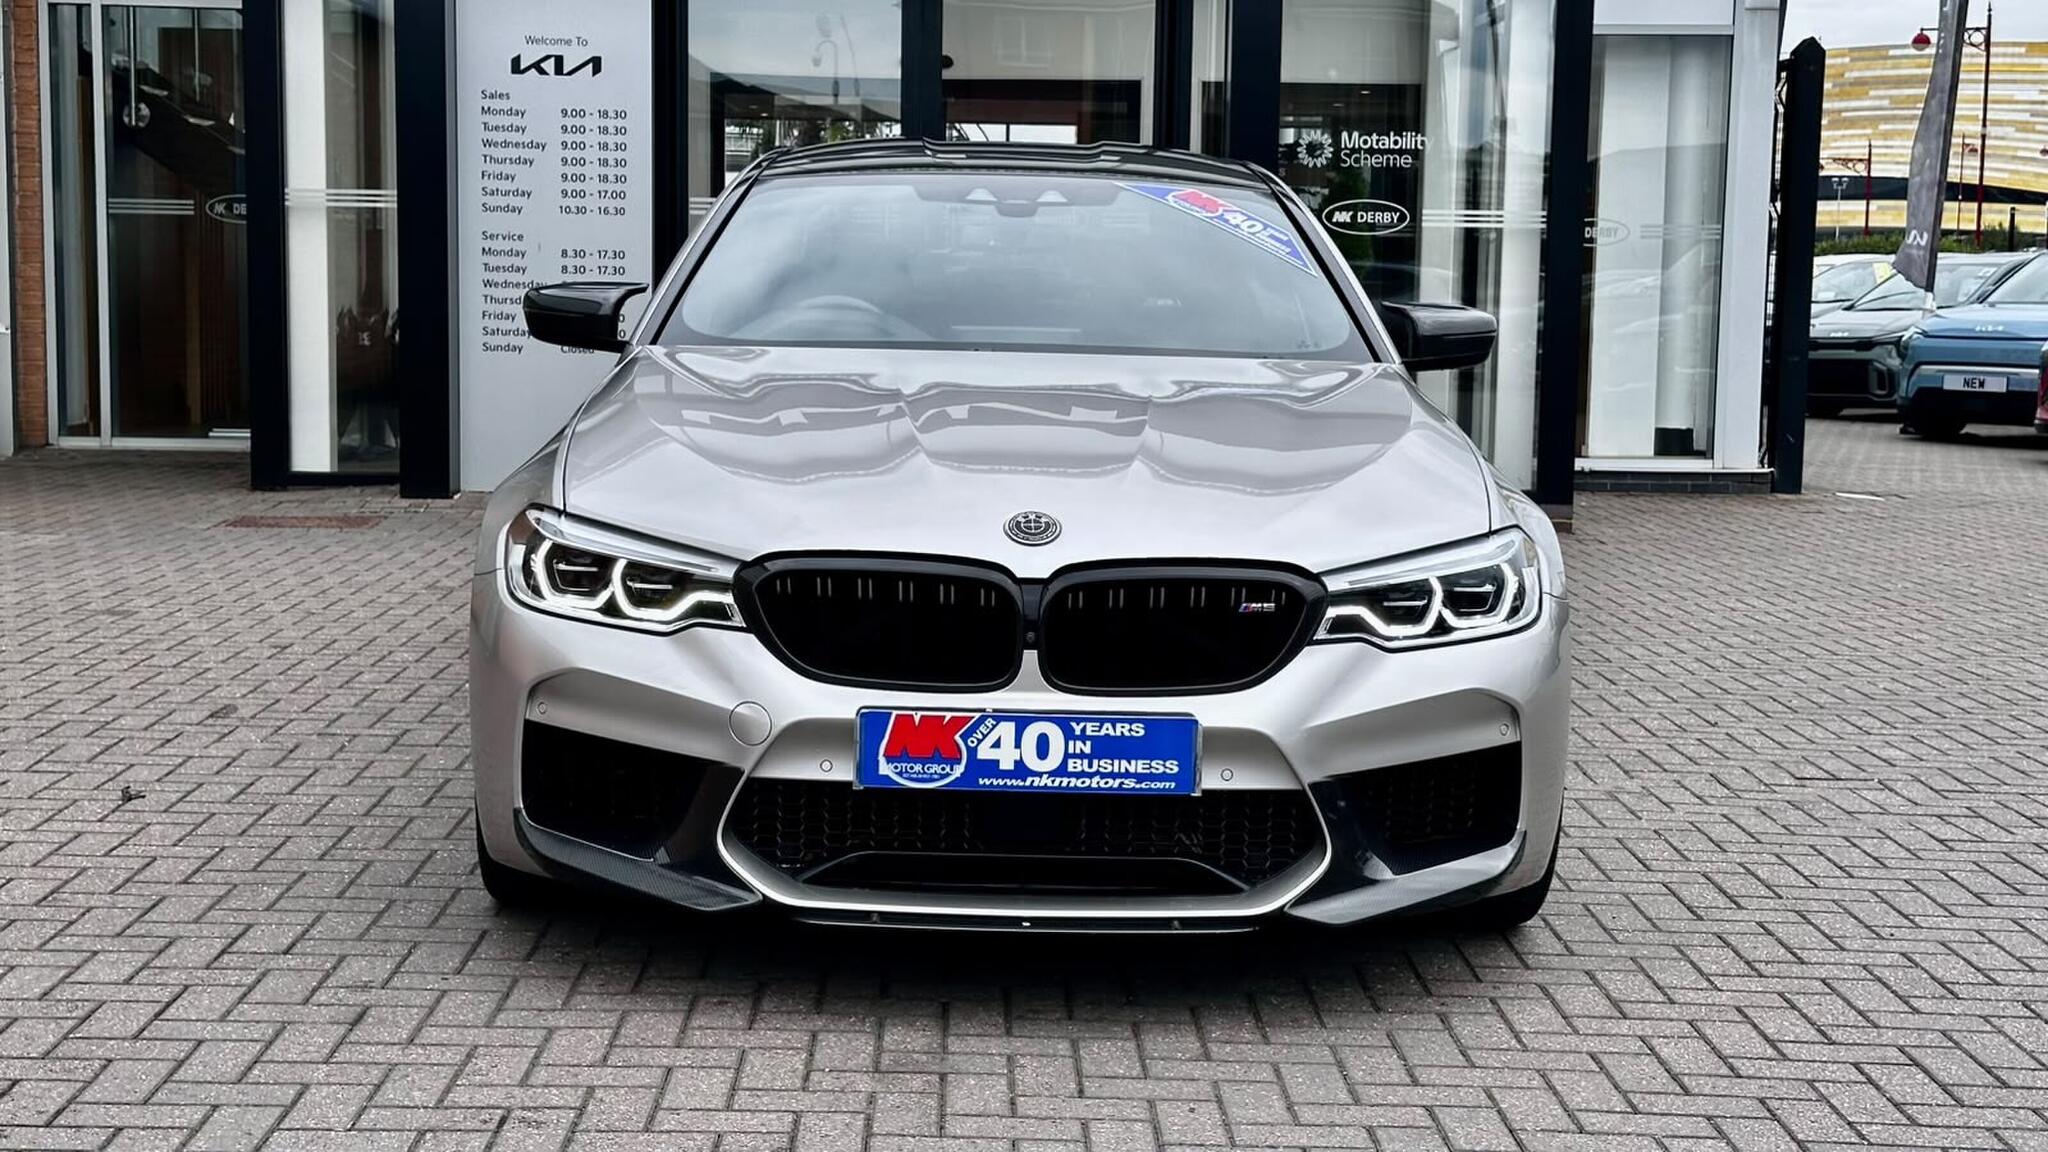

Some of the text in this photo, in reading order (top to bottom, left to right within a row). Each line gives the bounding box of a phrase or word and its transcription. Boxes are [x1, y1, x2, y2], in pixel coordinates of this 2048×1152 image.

[525, 36, 588, 47] Welcome To
[511, 54, 601, 77] KIA
[481, 90, 510, 100] Sales
[481, 106, 525, 118] Monday
[561, 109, 586, 118] 9.00
[598, 109, 627, 119] 18.30
[482, 122, 527, 135] Tuesday
[561, 125, 586, 134] 9.00
[598, 126, 626, 135] 18.30
[482, 138, 546, 152] Wednesday
[561, 141, 586, 150] 9.00
[598, 142, 626, 151] 18.30
[1340, 131, 1434, 151] Motability
[482, 154, 534, 167] Thursday
[561, 157, 586, 167] 9.00
[598, 158, 626, 168] 18.30
[1340, 150, 1412, 168] Scheme
[482, 171, 516, 182] Friday
[561, 173, 586, 183] 9.00
[598, 174, 626, 184] 18.30
[482, 187, 532, 199] Saturday
[561, 189, 586, 198] 9.00
[598, 190, 626, 200] 17.00
[482, 202, 523, 215] Sunday
[560, 206, 587, 215] 10.30
[598, 207, 625, 215] 16.30
[1332, 211, 1400, 224] NK DERBY
[482, 231, 523, 241] Service
[482, 247, 526, 259] Monday
[561, 249, 586, 258] 8.30
[598, 250, 625, 259] 17.30
[483, 263, 527, 275] Tuesday
[561, 265, 586, 274] 8.30
[598, 266, 625, 275] 17.30
[482, 294, 522, 305] Thursd
[482, 311, 516, 322] Friday
[483, 342, 523, 354] Sunday
[1963, 378, 1985, 389] NEW
[967, 717, 998, 748] OVER
[1069, 720, 1147, 737] YEARS
[884, 713, 976, 758] NK
[976, 721, 1065, 772] 40
[1067, 739, 1093, 755] IN
[1066, 758, 1181, 775] BUSINESS
[978, 773, 1176, 790] www.nkmotors.com
